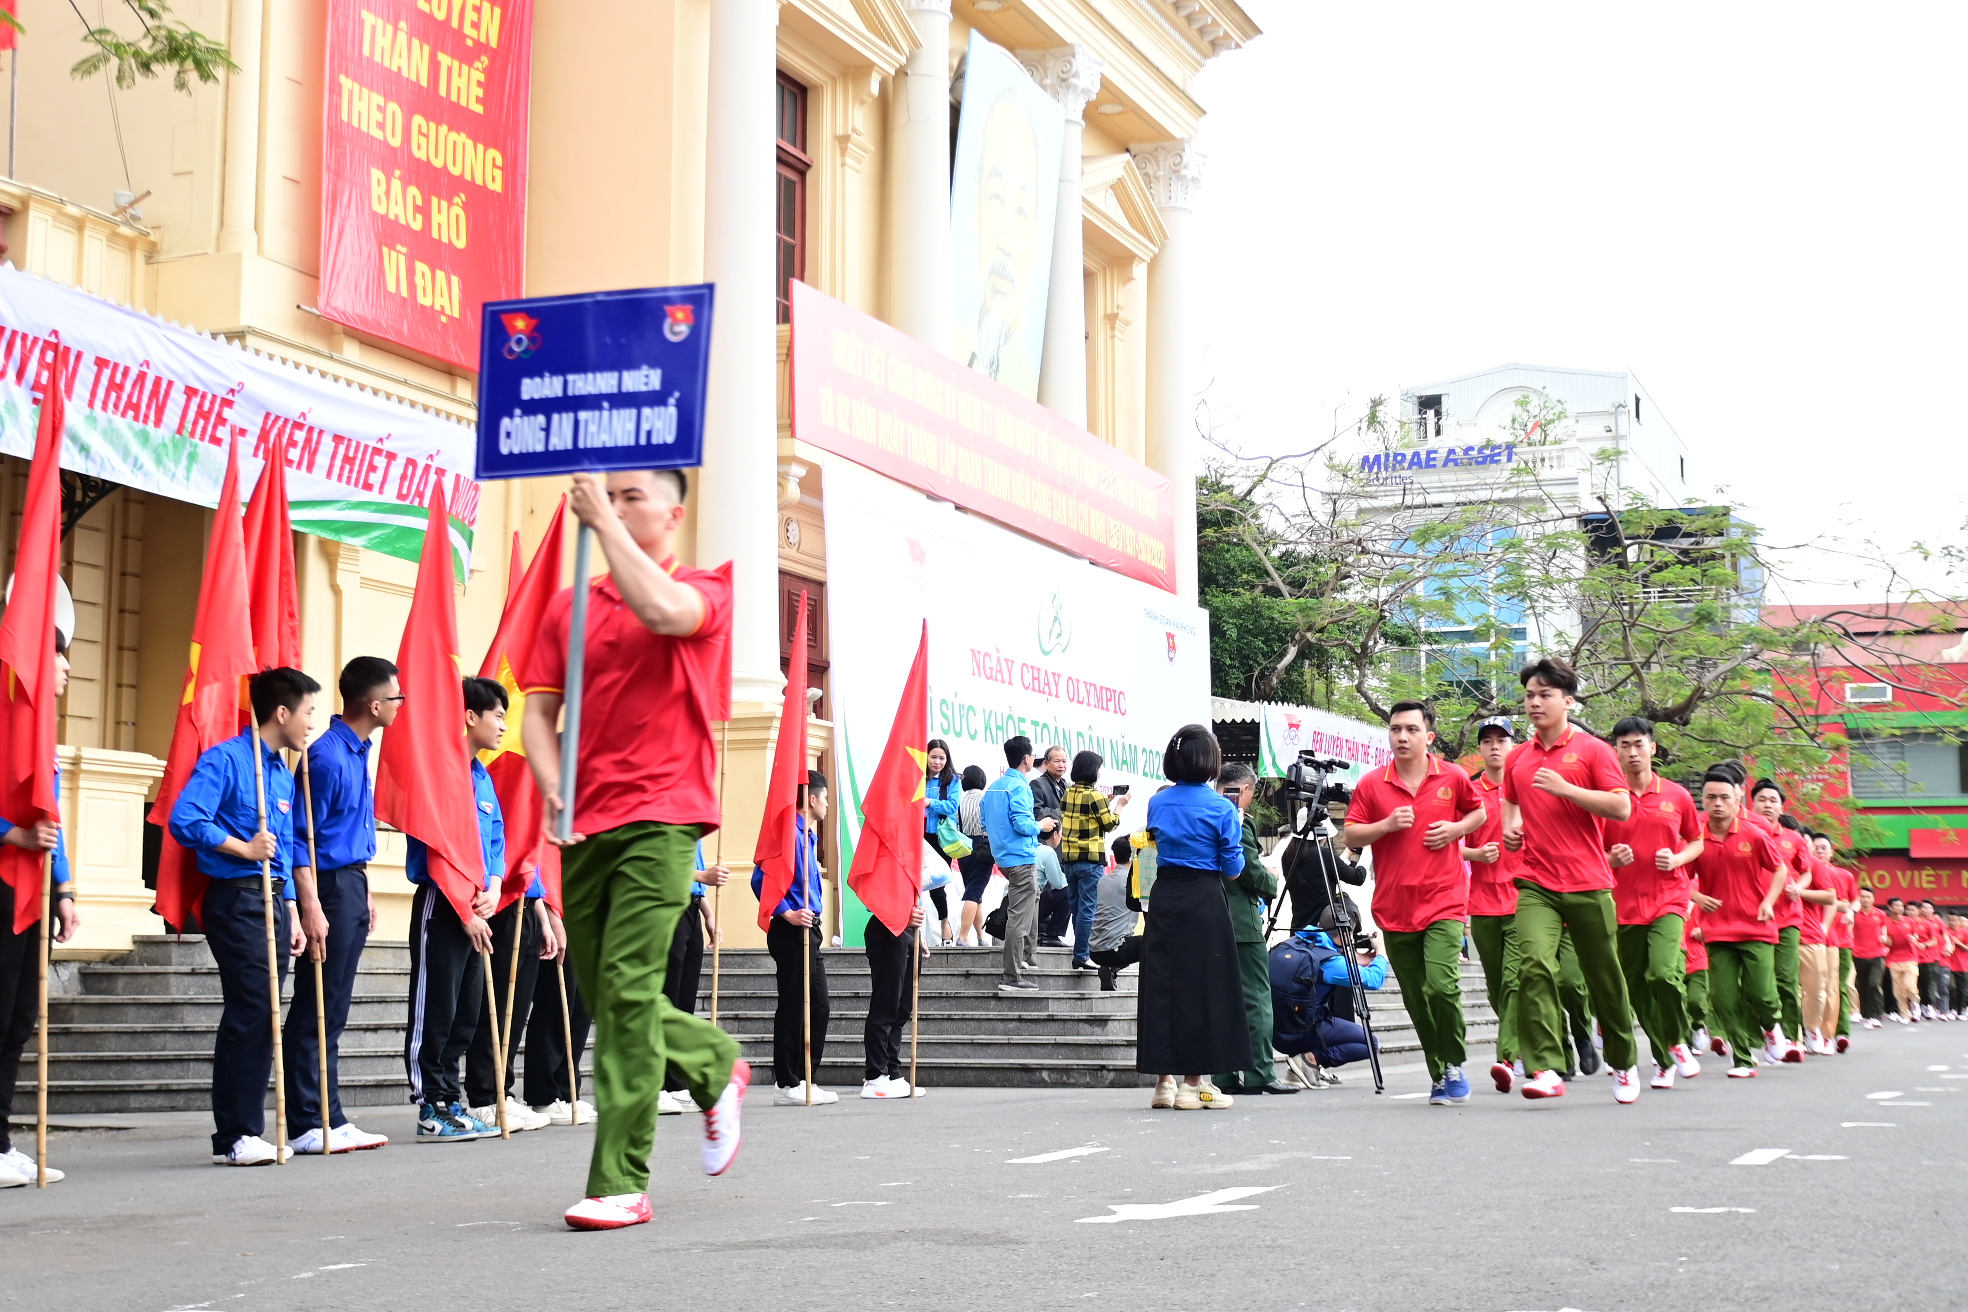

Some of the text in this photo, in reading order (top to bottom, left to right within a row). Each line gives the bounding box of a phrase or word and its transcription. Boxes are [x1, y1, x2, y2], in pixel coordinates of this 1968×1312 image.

[360, 8, 489, 115] THÂN THỂ
[339, 73, 503, 194] THEO GƯƠNG
[371, 166, 468, 250] BÁC HỒ
[382, 243, 461, 324] VĨ ĐẠI
[0, 325, 84, 406] UYỆN
[87, 356, 175, 430] THÂN
[175, 381, 245, 448] THỂ
[325, 433, 399, 496] THIẾT
[520, 364, 663, 400] ĐOÀN THANH NIÊN
[499, 390, 681, 456] CÔNG AN THÀNH PHỐ
[1360, 444, 1517, 473] MIRAE ASSET
[1364, 474, 1414, 486] ecurities
[969, 643, 1128, 716] NGÀY CHẠY OLYMPIC
[939, 691, 978, 741] SỨC
[1109, 735, 1139, 774] NĂM
[1895, 865, 1952, 892] VIỆT
